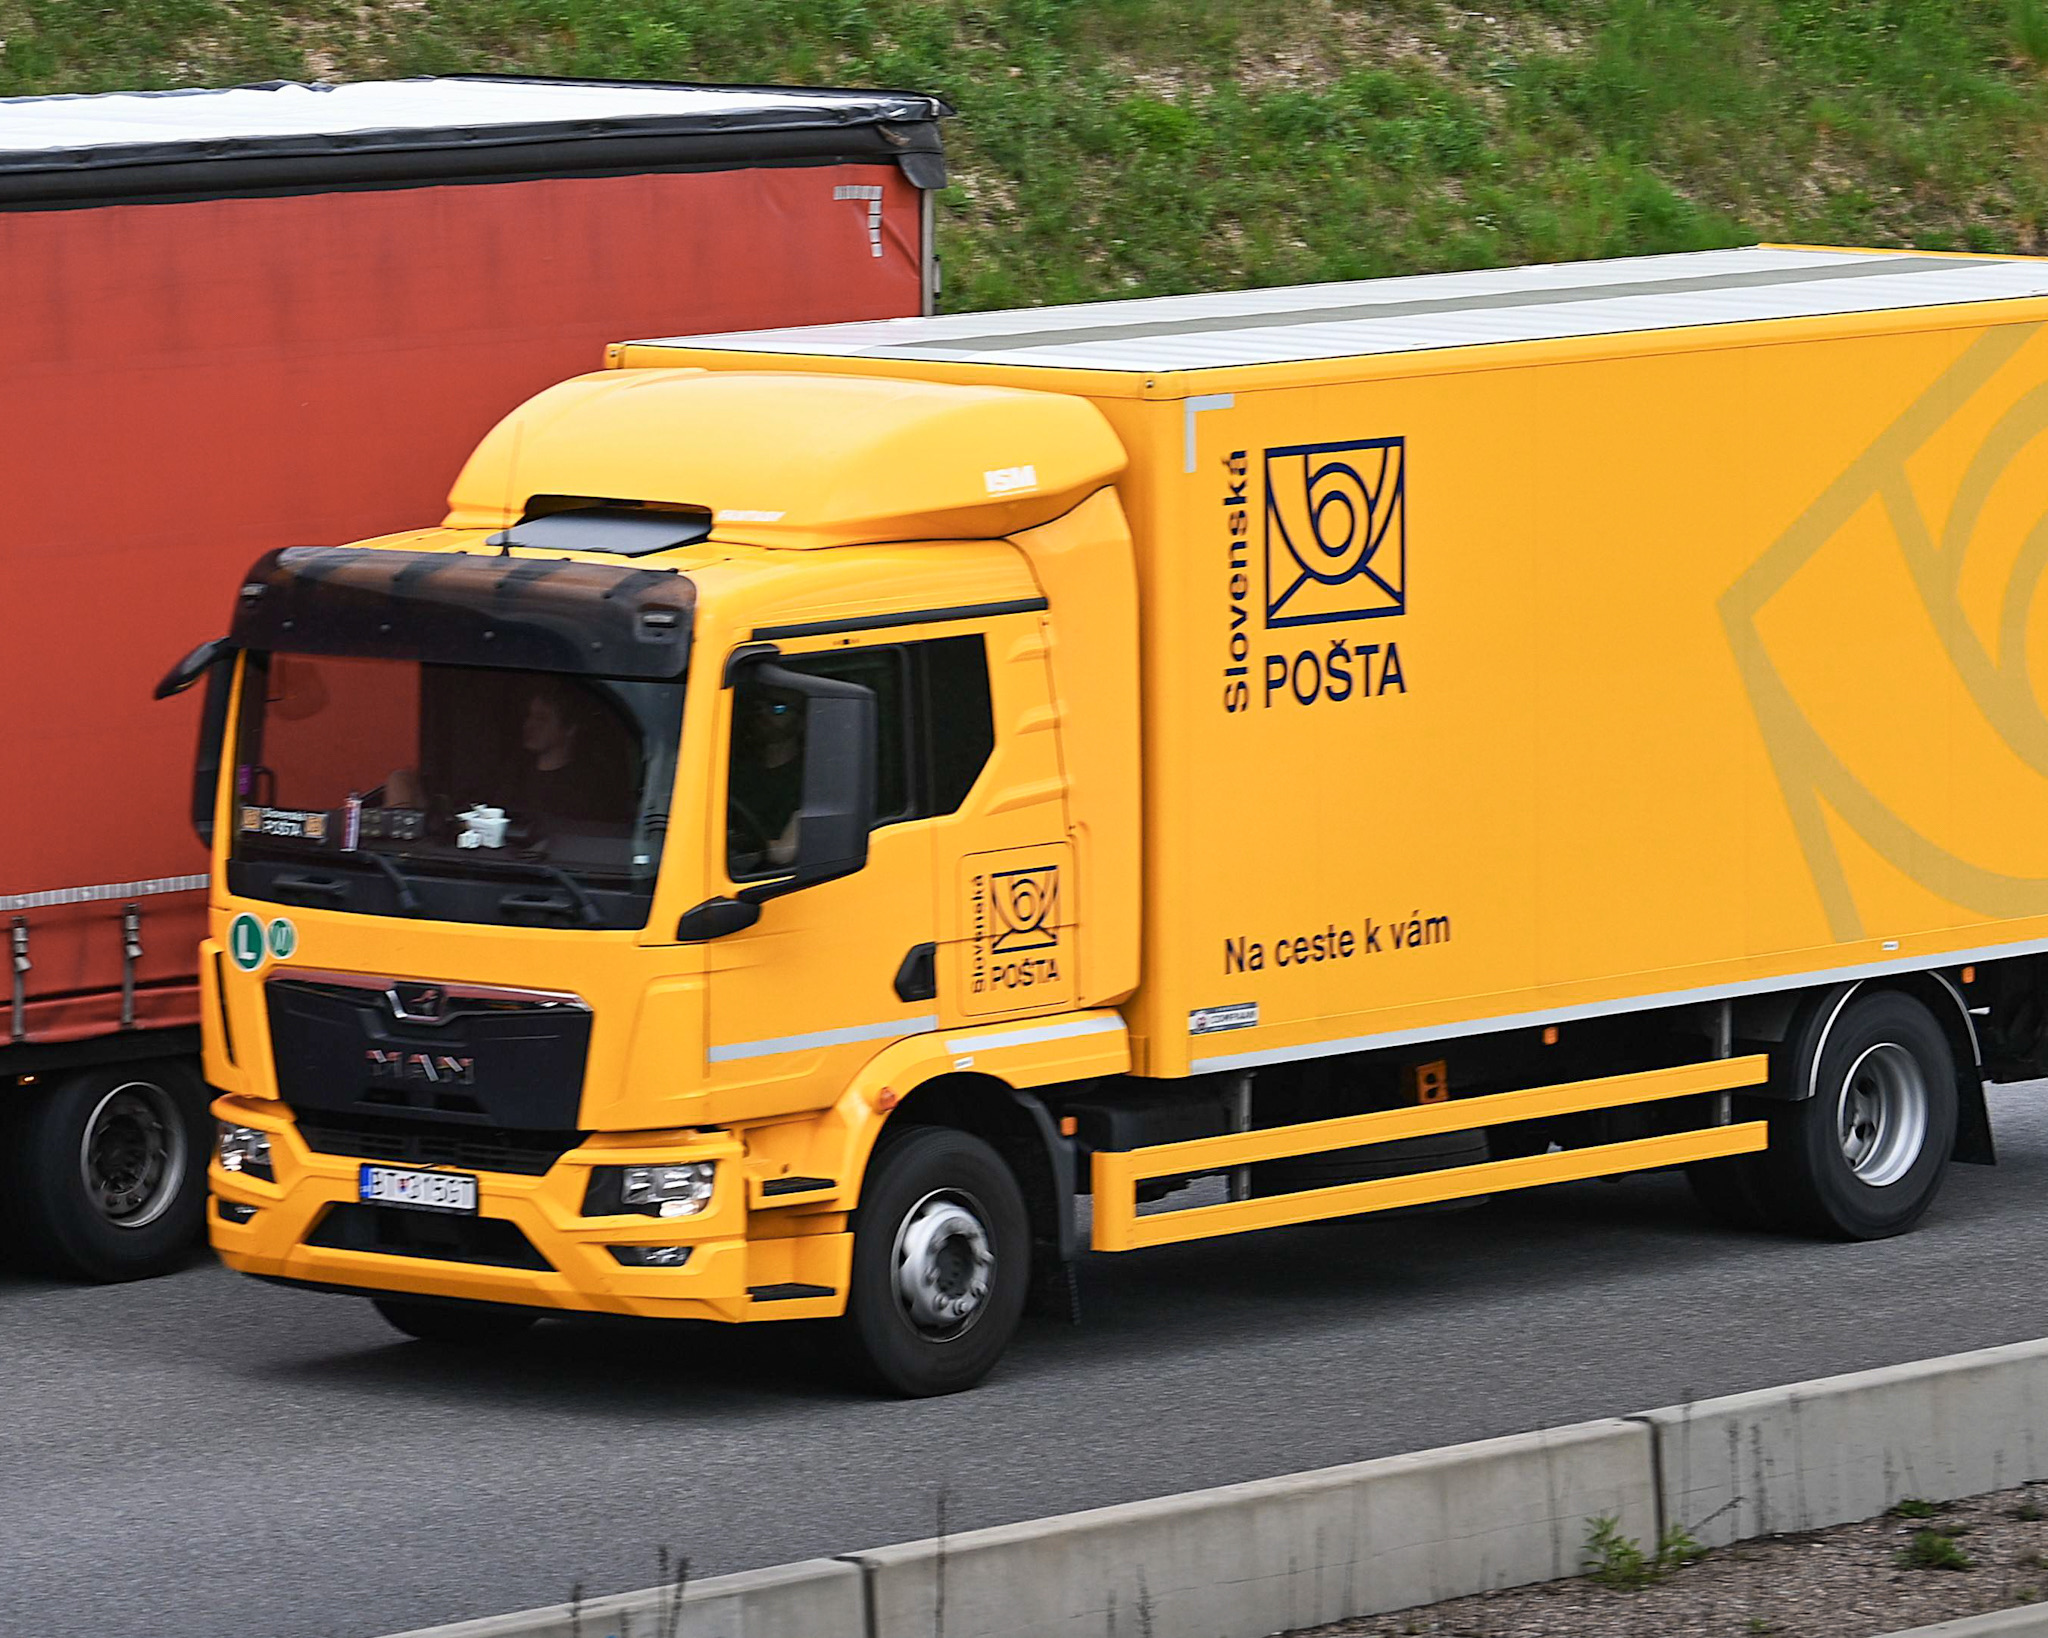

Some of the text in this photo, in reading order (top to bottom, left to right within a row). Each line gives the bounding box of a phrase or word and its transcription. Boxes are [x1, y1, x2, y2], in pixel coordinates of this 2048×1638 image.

[1222, 450, 1248, 713] Slovenská
[1264, 638, 1407, 708] POŠTA
[238, 923, 257, 960] L
[1224, 910, 1450, 975] Na ceste k vám
[365, 1049, 475, 1085] MAN
